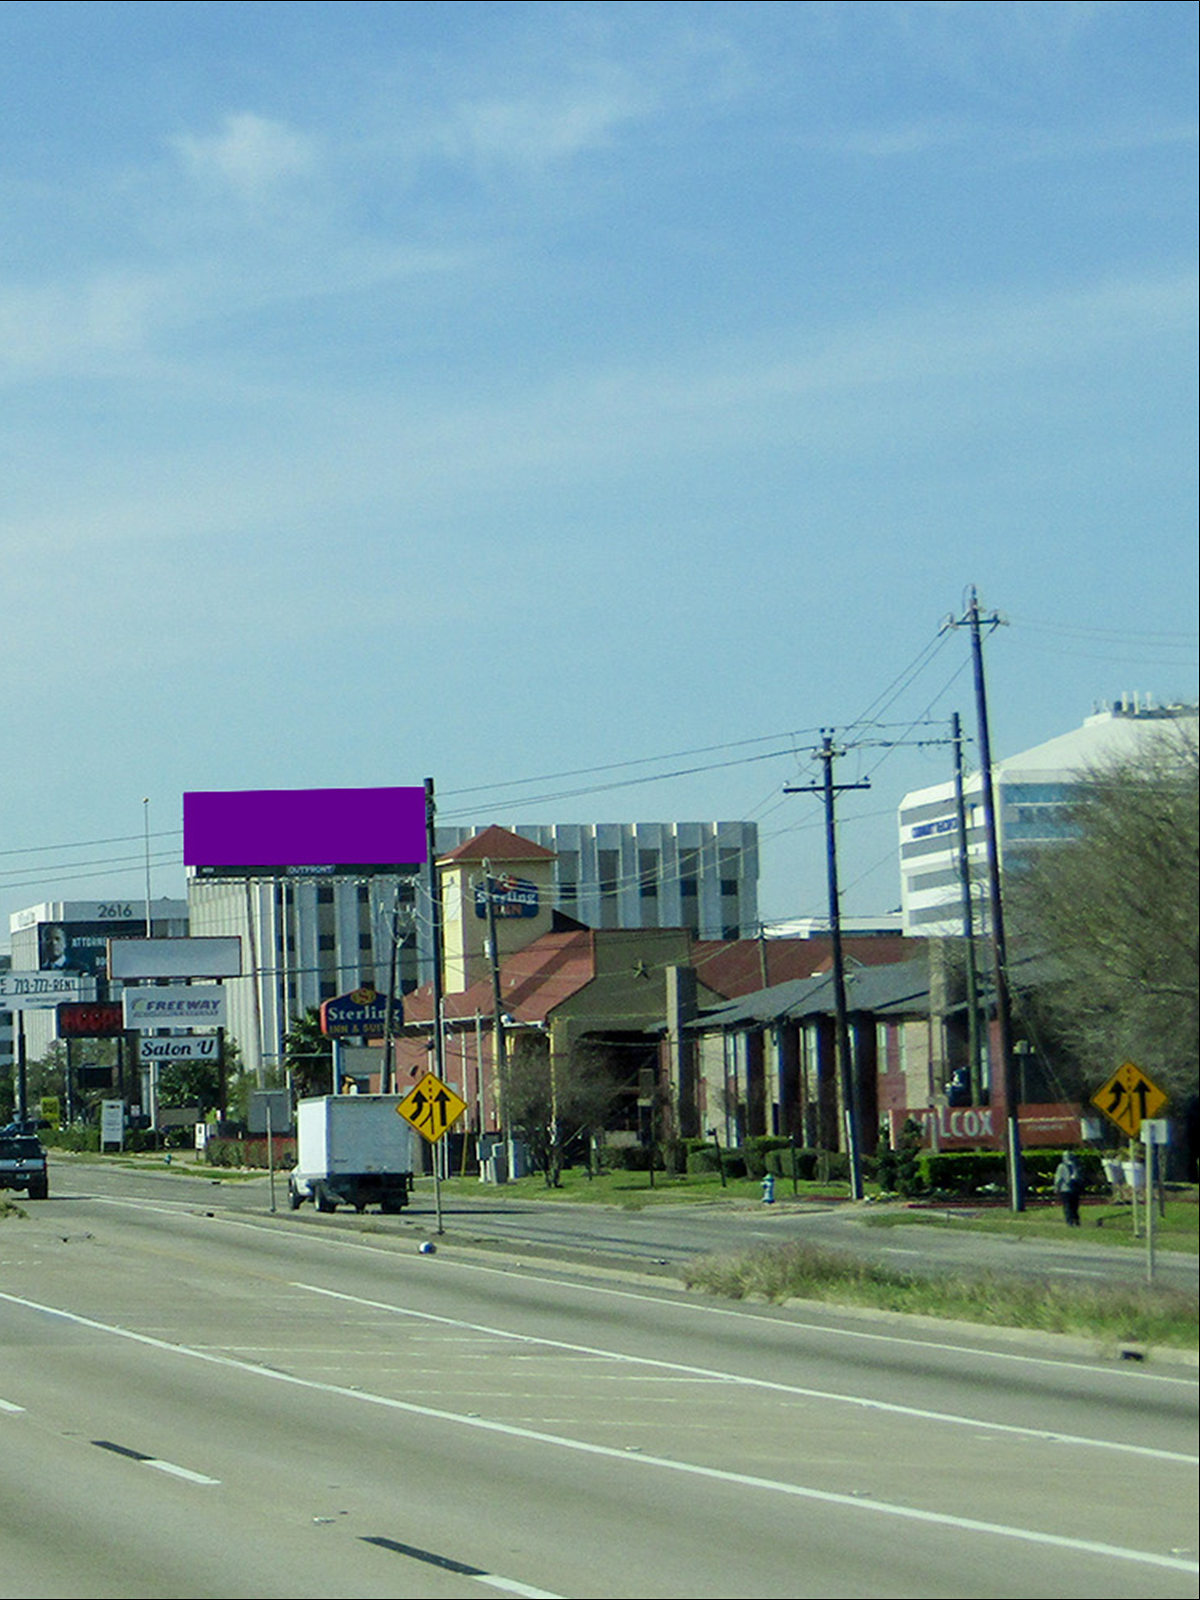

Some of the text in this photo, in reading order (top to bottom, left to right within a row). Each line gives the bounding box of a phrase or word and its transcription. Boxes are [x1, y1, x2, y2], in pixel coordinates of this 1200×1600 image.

[476, 890, 537, 905] Serling
[98, 904, 132, 918] 2616
[72, 937, 107, 947] ATTORNE
[14, 977, 77, 994] 713-777-RENT
[146, 999, 221, 1010] FREEWAY
[141, 1040, 215, 1057] Salon U
